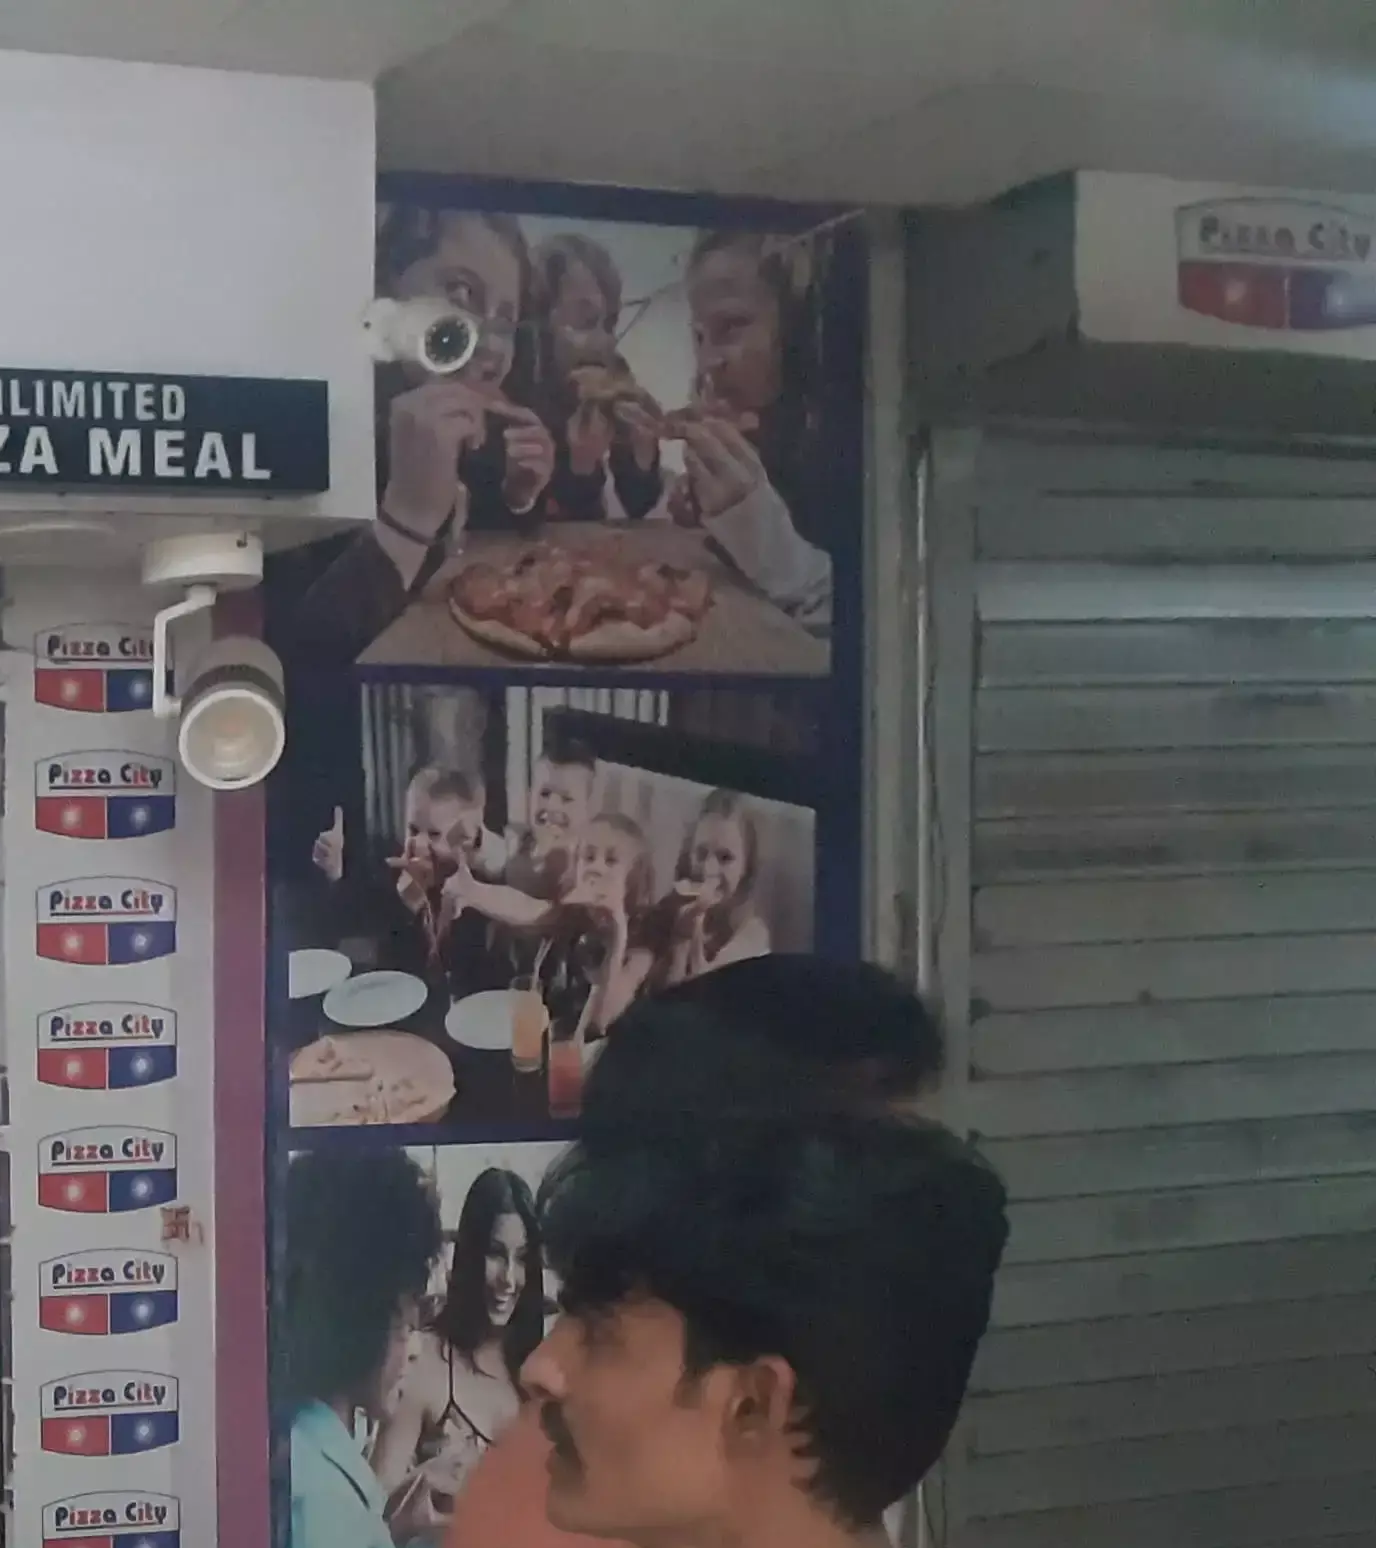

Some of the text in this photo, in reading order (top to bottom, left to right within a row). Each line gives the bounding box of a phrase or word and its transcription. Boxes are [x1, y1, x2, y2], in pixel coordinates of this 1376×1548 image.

[88, 429, 272, 481] MEAL
[48, 635, 110, 656] Pizza
[49, 763, 162, 788] Pizza City
[50, 889, 163, 914] Pizza City
[50, 1014, 164, 1039] Pizza City
[51, 1138, 164, 1162] Pizza City
[53, 1260, 165, 1284] Pizza City
[54, 1382, 166, 1405] Pizza City
[55, 1502, 167, 1526] Pizza City
